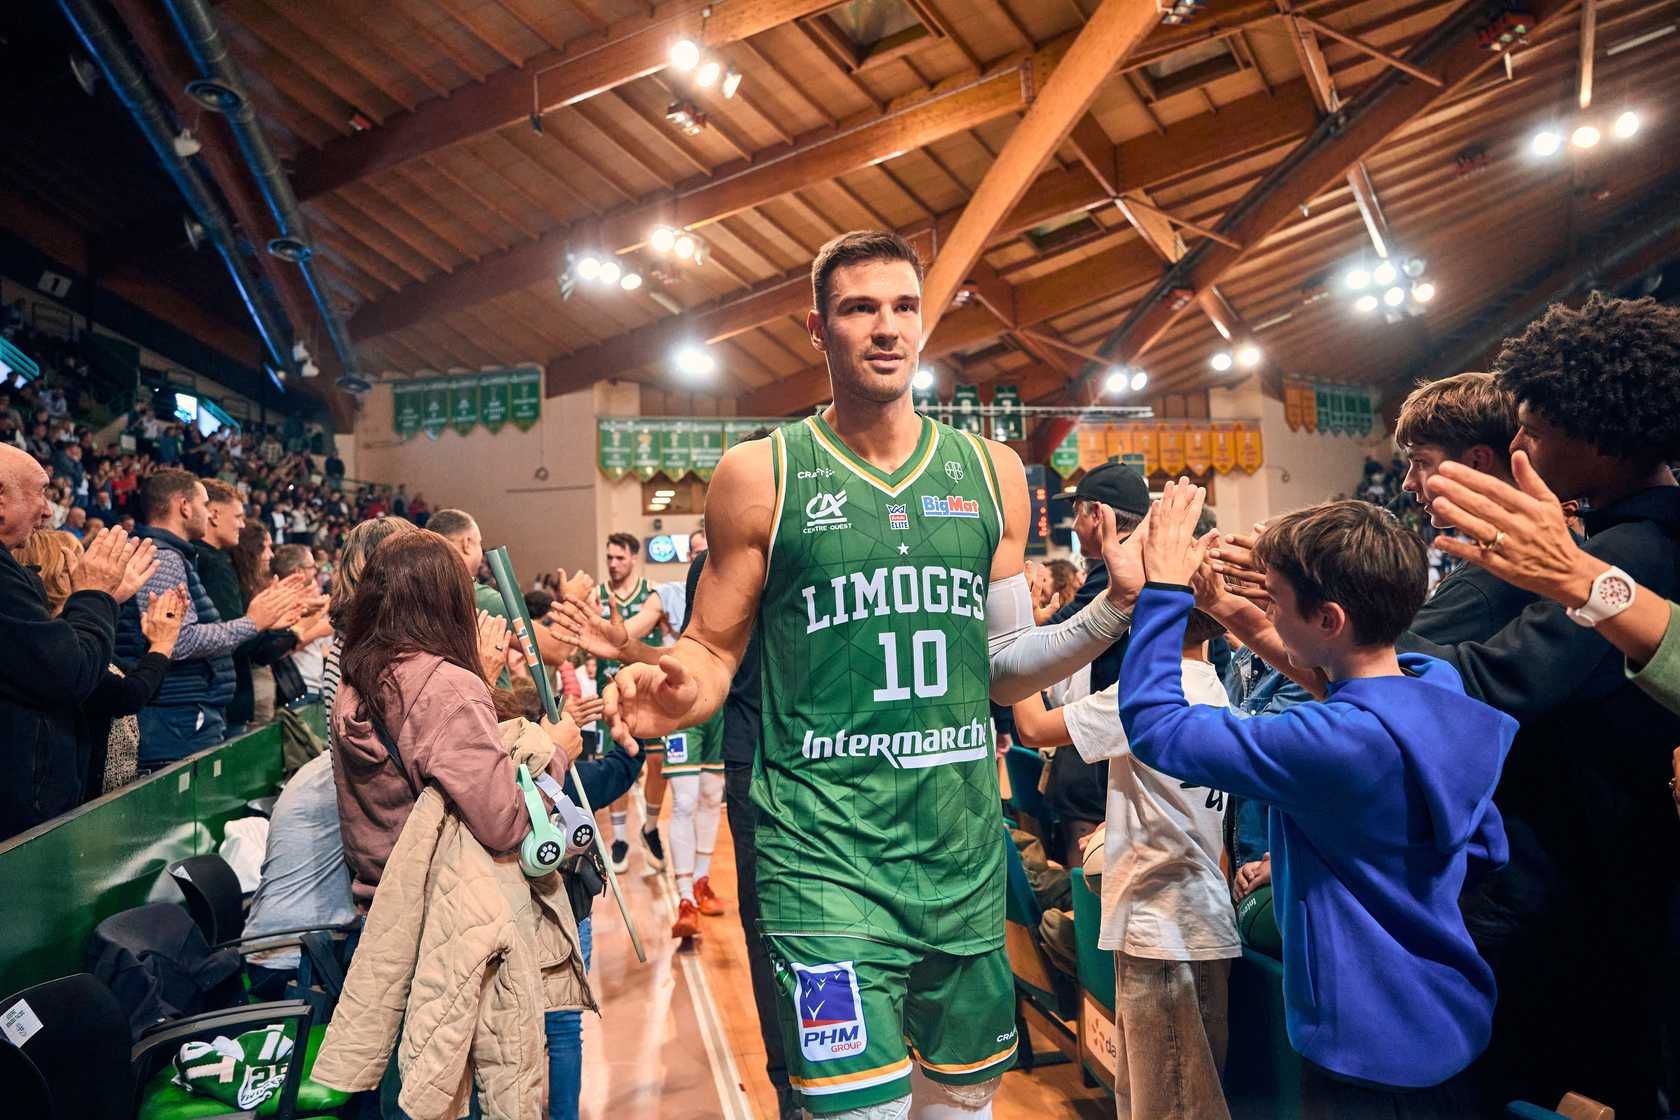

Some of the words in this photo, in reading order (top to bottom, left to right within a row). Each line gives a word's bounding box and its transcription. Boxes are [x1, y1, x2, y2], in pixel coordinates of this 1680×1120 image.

[923, 495, 979, 515] BigMat
[891, 521, 909, 529] ELITE
[802, 566, 986, 634] LIMOGES
[873, 629, 949, 702] 10
[804, 1024, 860, 1048] PHM
[831, 1040, 863, 1053] GROUP
